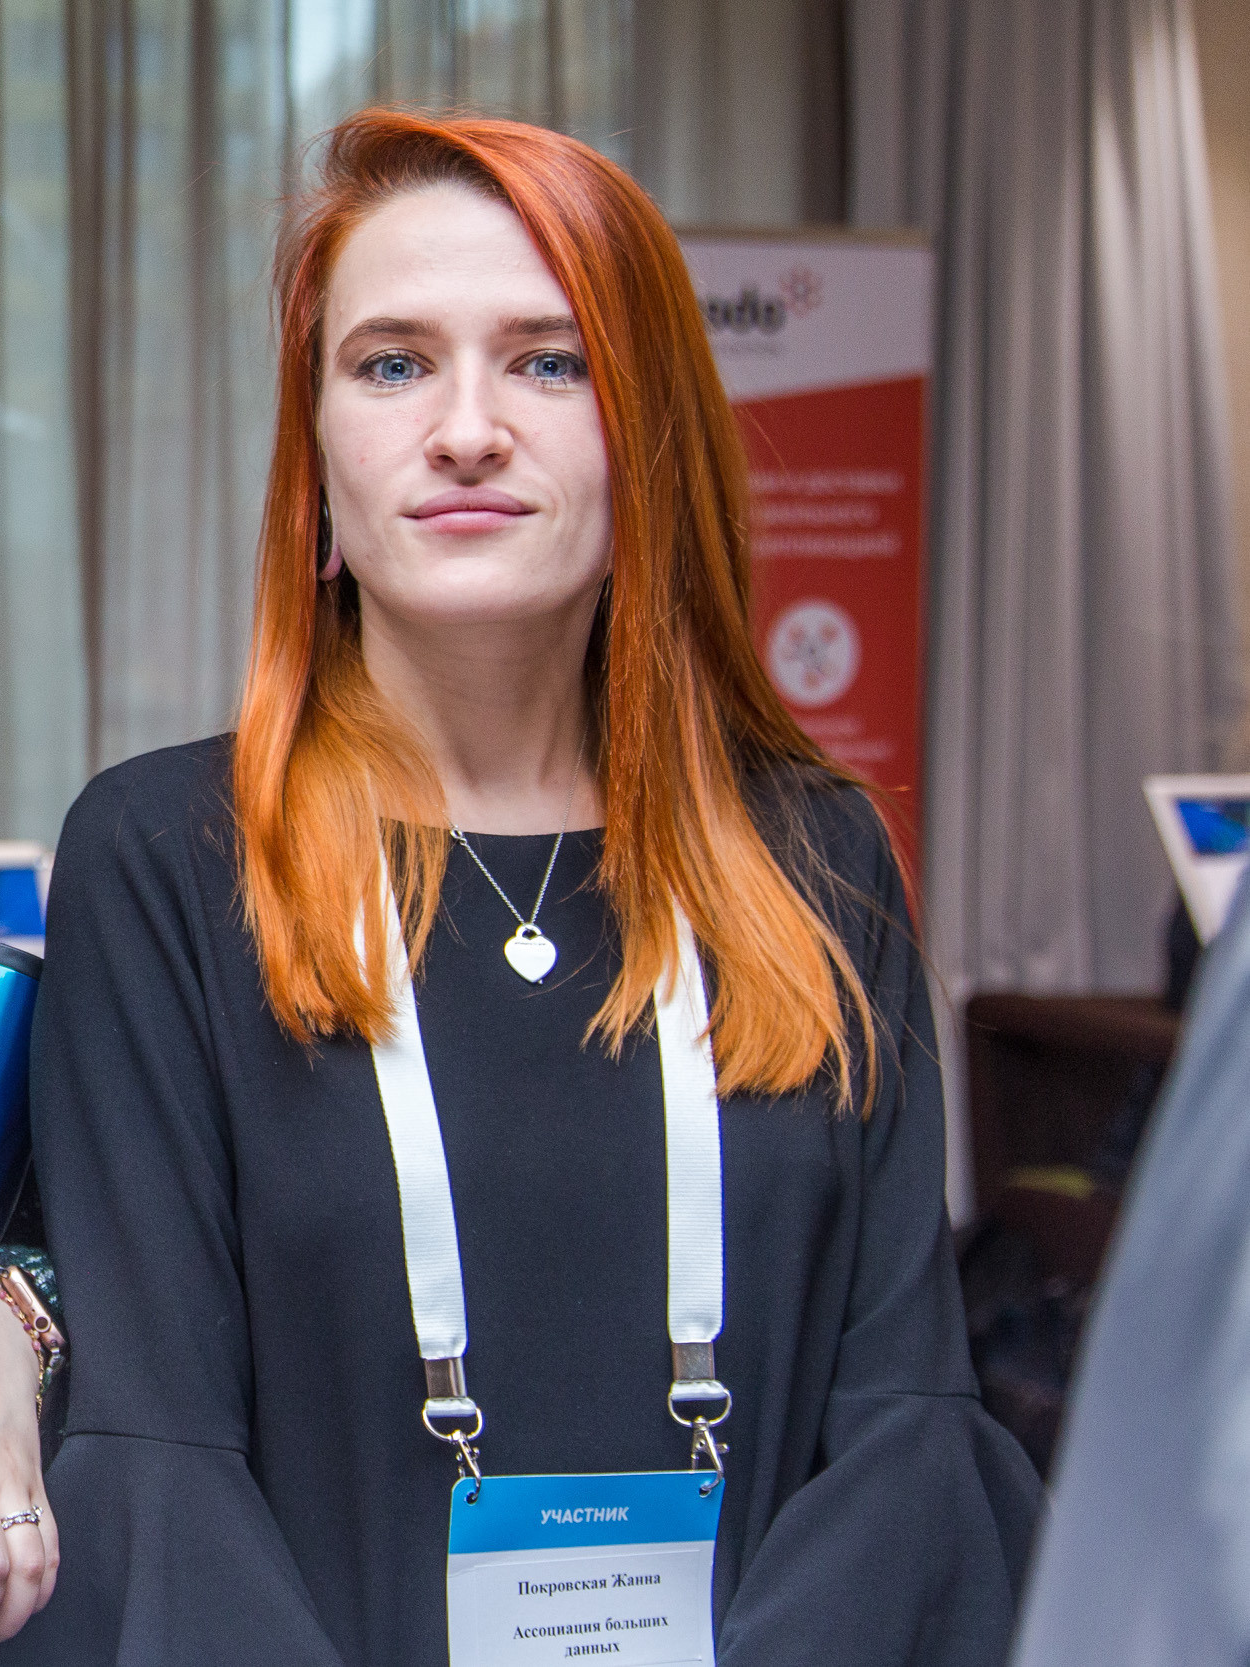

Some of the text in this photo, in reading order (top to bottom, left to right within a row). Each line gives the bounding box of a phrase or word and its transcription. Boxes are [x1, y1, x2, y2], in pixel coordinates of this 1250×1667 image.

[540, 1506, 630, 1525] УЧАСТНИК
[518, 1573, 661, 1597] Покровская Жанна
[513, 1616, 669, 1640] Ассоциация больших
[564, 1642, 621, 1658] данных
